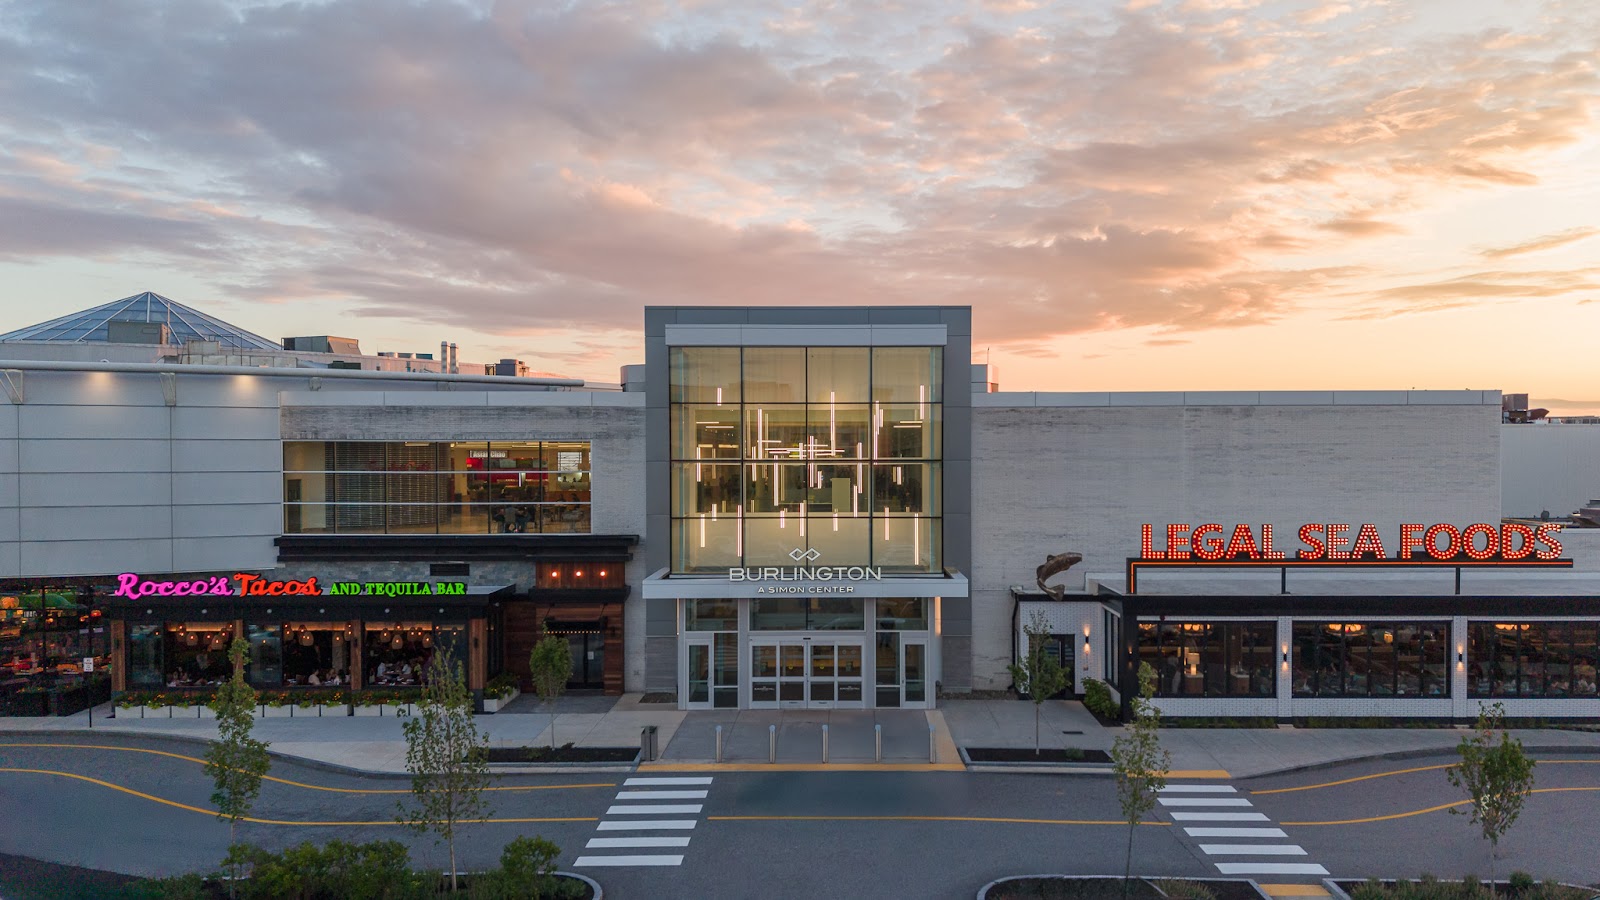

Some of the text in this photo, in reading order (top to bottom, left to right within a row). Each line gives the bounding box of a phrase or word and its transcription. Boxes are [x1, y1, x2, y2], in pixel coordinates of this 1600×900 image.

[1140, 523, 1563, 560] LEGAL SEA FOODS
[114, 572, 465, 600] Rocco's Tacos AND TEQUILA BAR
[729, 567, 881, 581] BURLINGTON
